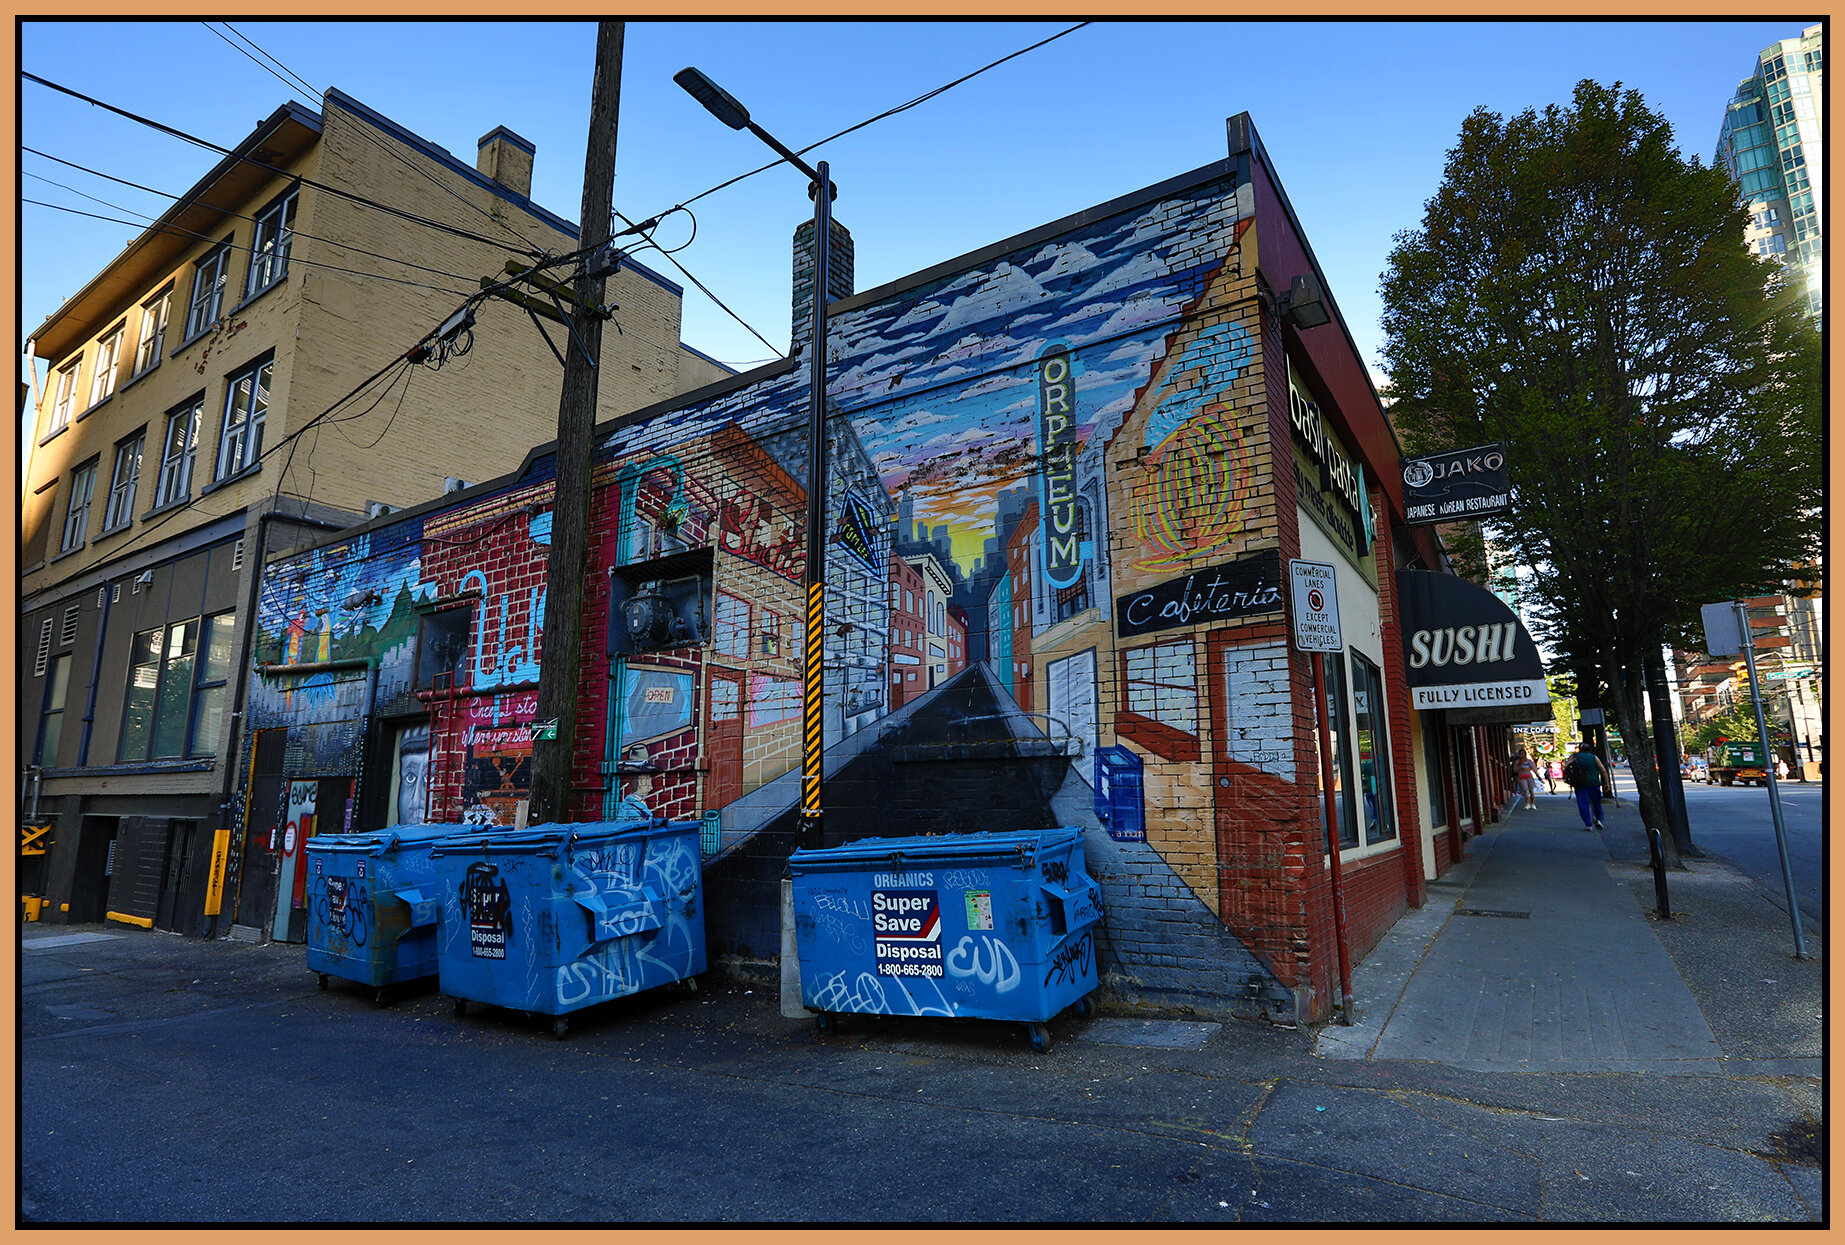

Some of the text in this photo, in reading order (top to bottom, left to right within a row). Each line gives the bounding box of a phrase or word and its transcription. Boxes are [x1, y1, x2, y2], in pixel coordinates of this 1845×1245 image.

[1286, 353, 1325, 464] basil
[1327, 437, 1359, 513] pasta
[1043, 357, 1078, 569] ORPHEUM
[1434, 451, 1504, 479] JAKO
[1406, 493, 1508, 519] JAPANESE KOREAN RESTAURANT
[719, 489, 807, 580] Studio
[1295, 566, 1332, 579] COMMERCIAL
[1304, 578, 1325, 589] LANES
[1126, 575, 1282, 625] Cafeteria
[1305, 612, 1329, 623] EXCEPT
[1300, 623, 1337, 634] COMMERCIAL
[1304, 634, 1335, 645] VEHICLES
[1409, 621, 1517, 669] SUSHI
[646, 688, 671, 702] OPEN
[1418, 685, 1532, 704] FULLY LICENSED
[461, 723, 491, 747] where
[873, 872, 934, 888] ORGANICS
[873, 892, 931, 914] Super
[874, 913, 922, 932] Save
[471, 930, 505, 945] Disposal
[472, 946, 505, 959] 1-800-665-2800
[876, 943, 942, 962] Disposal
[877, 963, 943, 977] 1-800-665-2800
